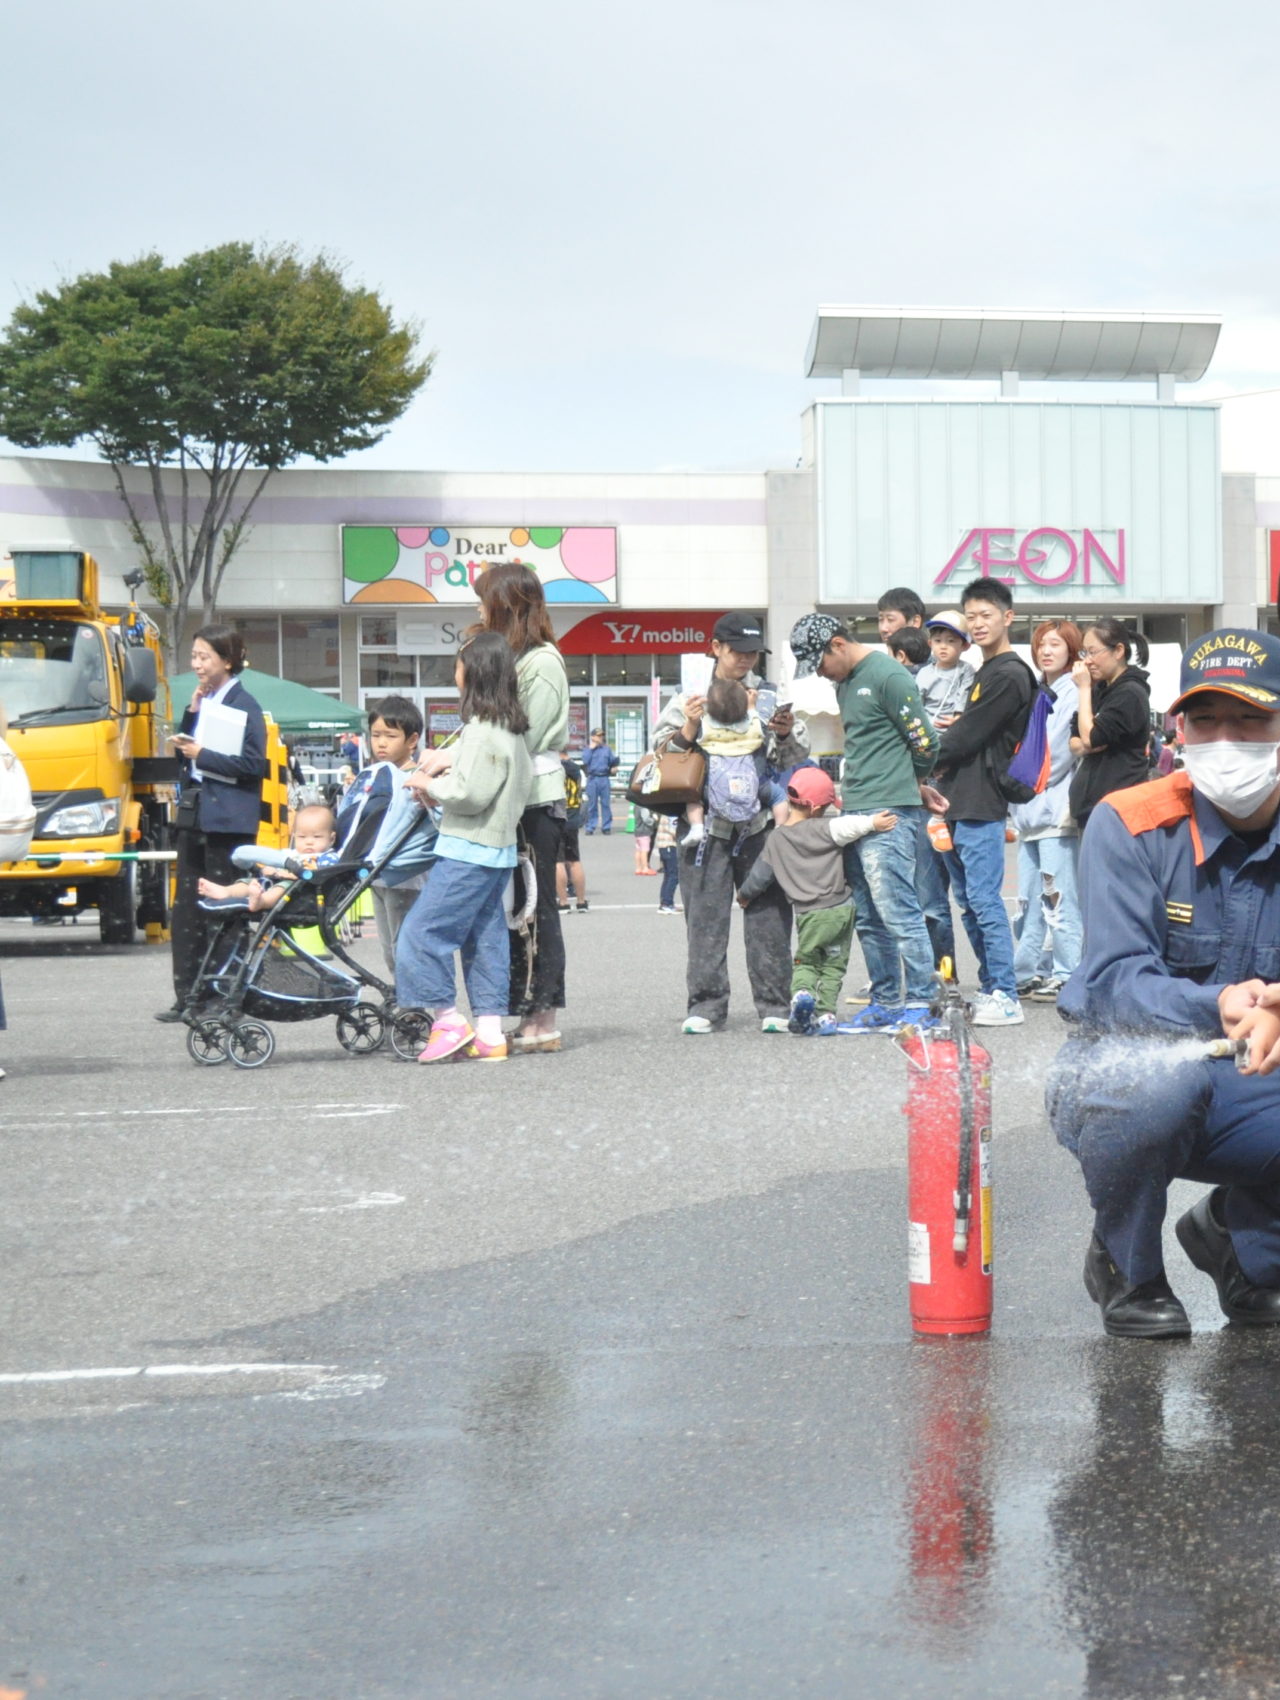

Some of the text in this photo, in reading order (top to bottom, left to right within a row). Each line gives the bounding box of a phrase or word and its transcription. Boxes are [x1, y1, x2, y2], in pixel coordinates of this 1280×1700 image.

[455, 537, 507, 556] Dear
[1189, 634, 1268, 669] SUKAGAWA
[1200, 656, 1257, 670] FIRE DEPT.
